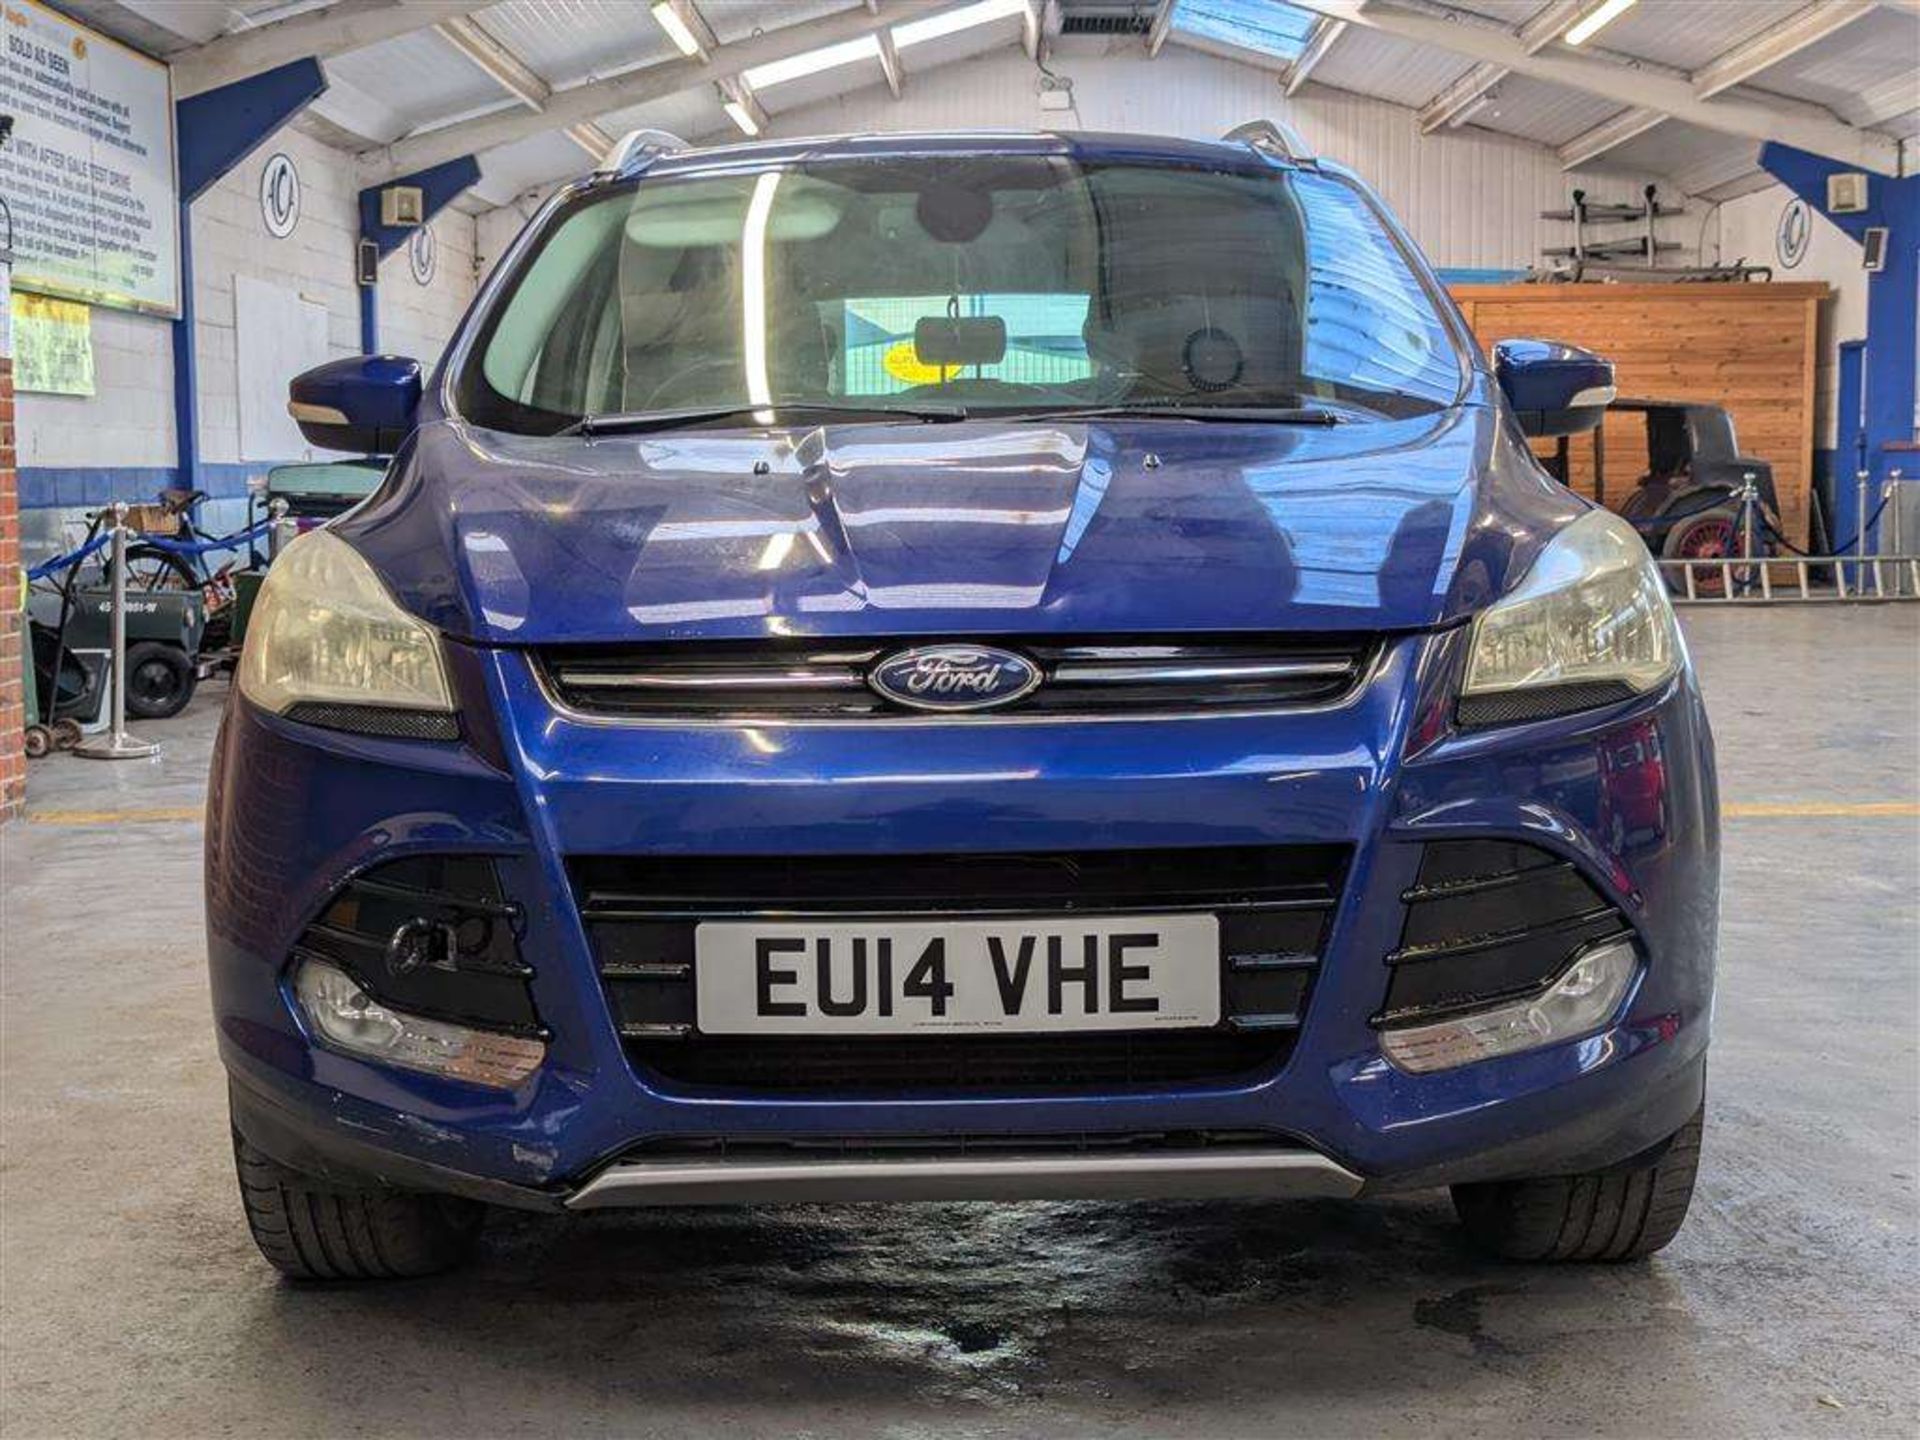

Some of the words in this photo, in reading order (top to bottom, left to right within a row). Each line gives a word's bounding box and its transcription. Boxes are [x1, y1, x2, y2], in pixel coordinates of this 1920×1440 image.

[9, 34, 32, 59] SOLD
[34, 46, 46, 66] AS
[48, 51, 70, 75] SEEN
[16, 137, 37, 162] WITH
[39, 145, 64, 171] AFTER
[67, 154, 87, 178] SALE
[89, 162, 108, 185] TEST
[109, 169, 131, 193] DRIVE
[906, 656, 1001, 693] Ford
[756, 937, 954, 1016] EU14
[986, 933, 1160, 1015] VHE
